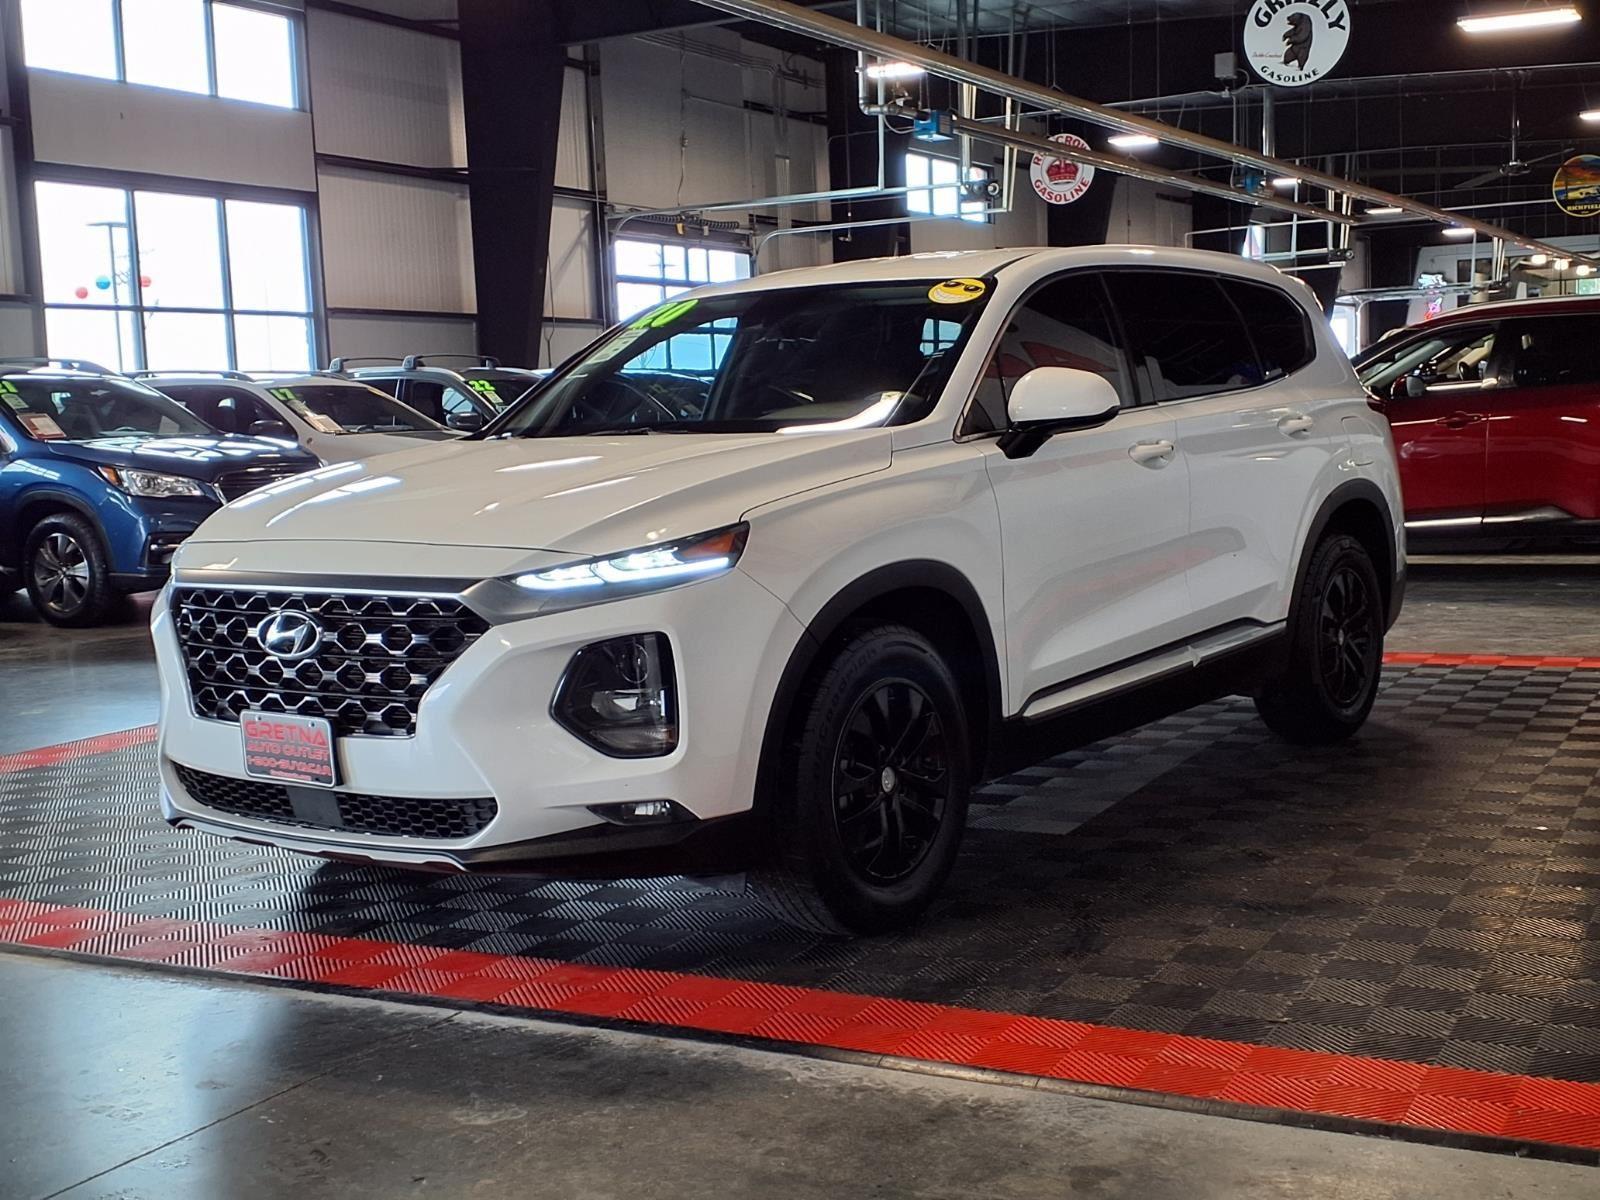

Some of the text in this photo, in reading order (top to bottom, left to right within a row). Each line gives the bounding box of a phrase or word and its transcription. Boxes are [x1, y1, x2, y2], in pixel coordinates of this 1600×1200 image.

[1261, 65, 1320, 83] GASOLINE
[1034, 177, 1090, 203] GASOLINE
[468, 380, 496, 391] 22
[245, 720, 327, 746] GRETNA
